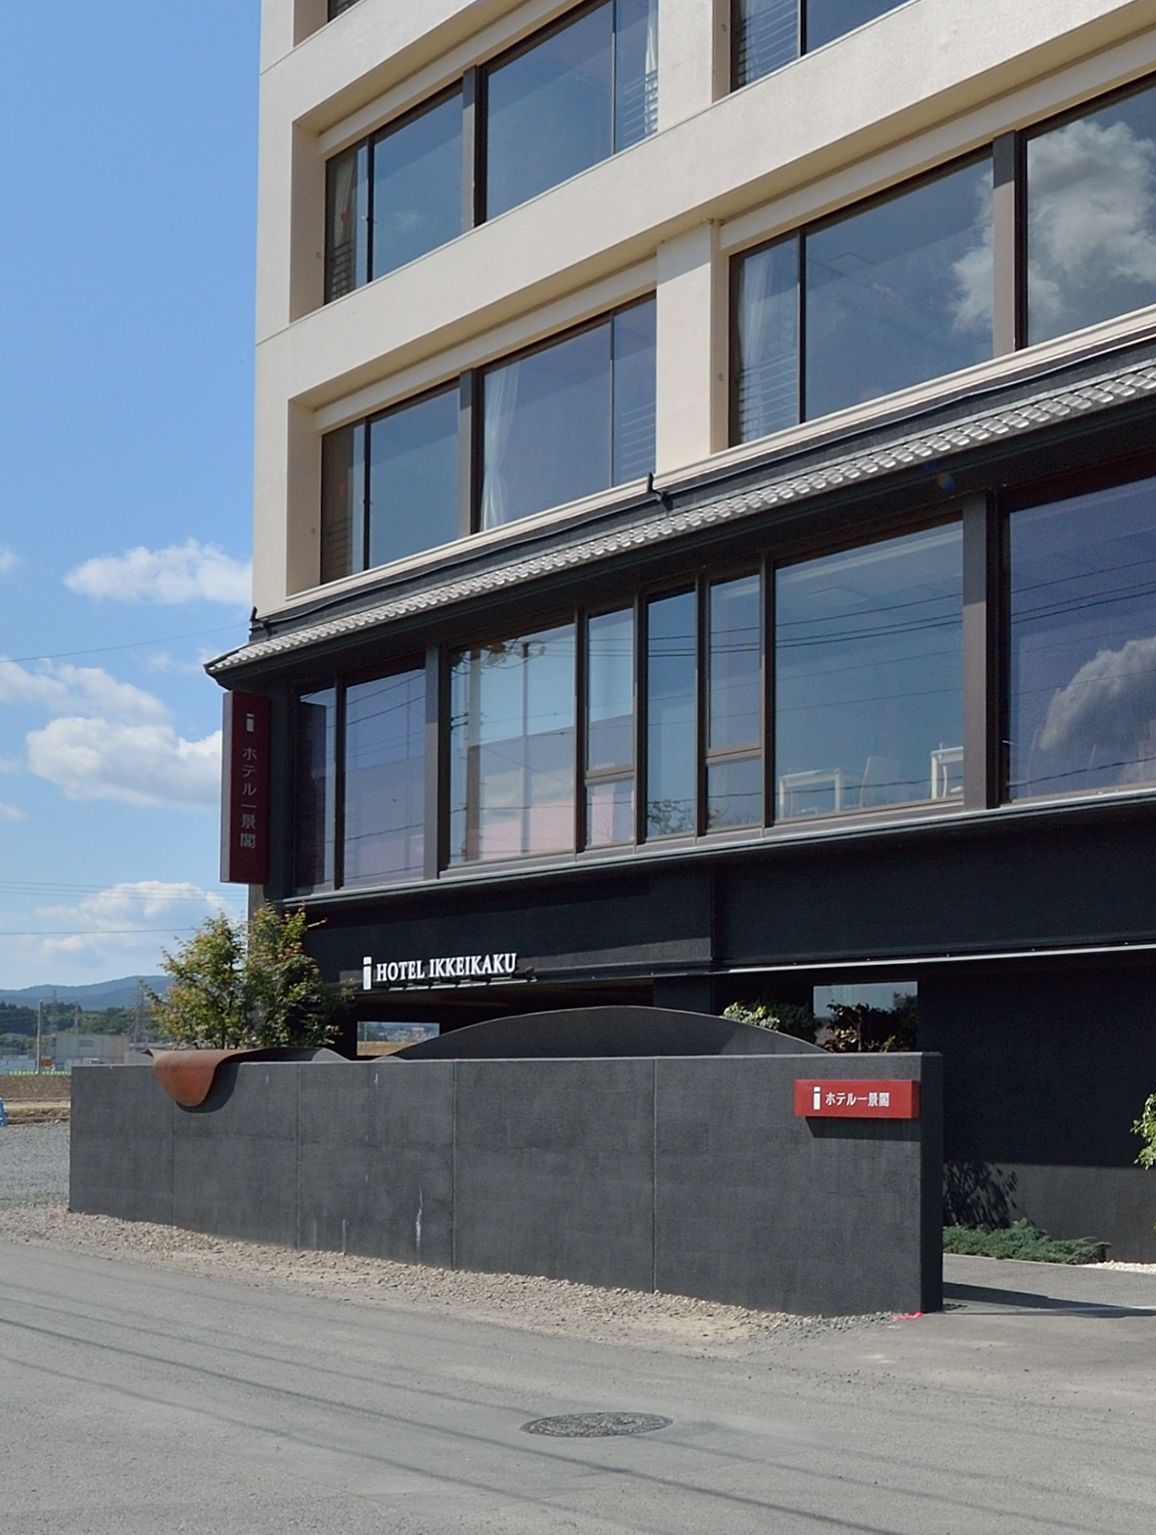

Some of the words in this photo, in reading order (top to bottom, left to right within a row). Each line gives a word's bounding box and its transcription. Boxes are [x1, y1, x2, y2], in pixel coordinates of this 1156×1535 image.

[240, 747, 257, 849] ホテル一景閣
[376, 960, 425, 982] HOTEL
[429, 953, 517, 977] IKKEIKAKU
[825, 1092, 890, 1107] ホテル一景閣
